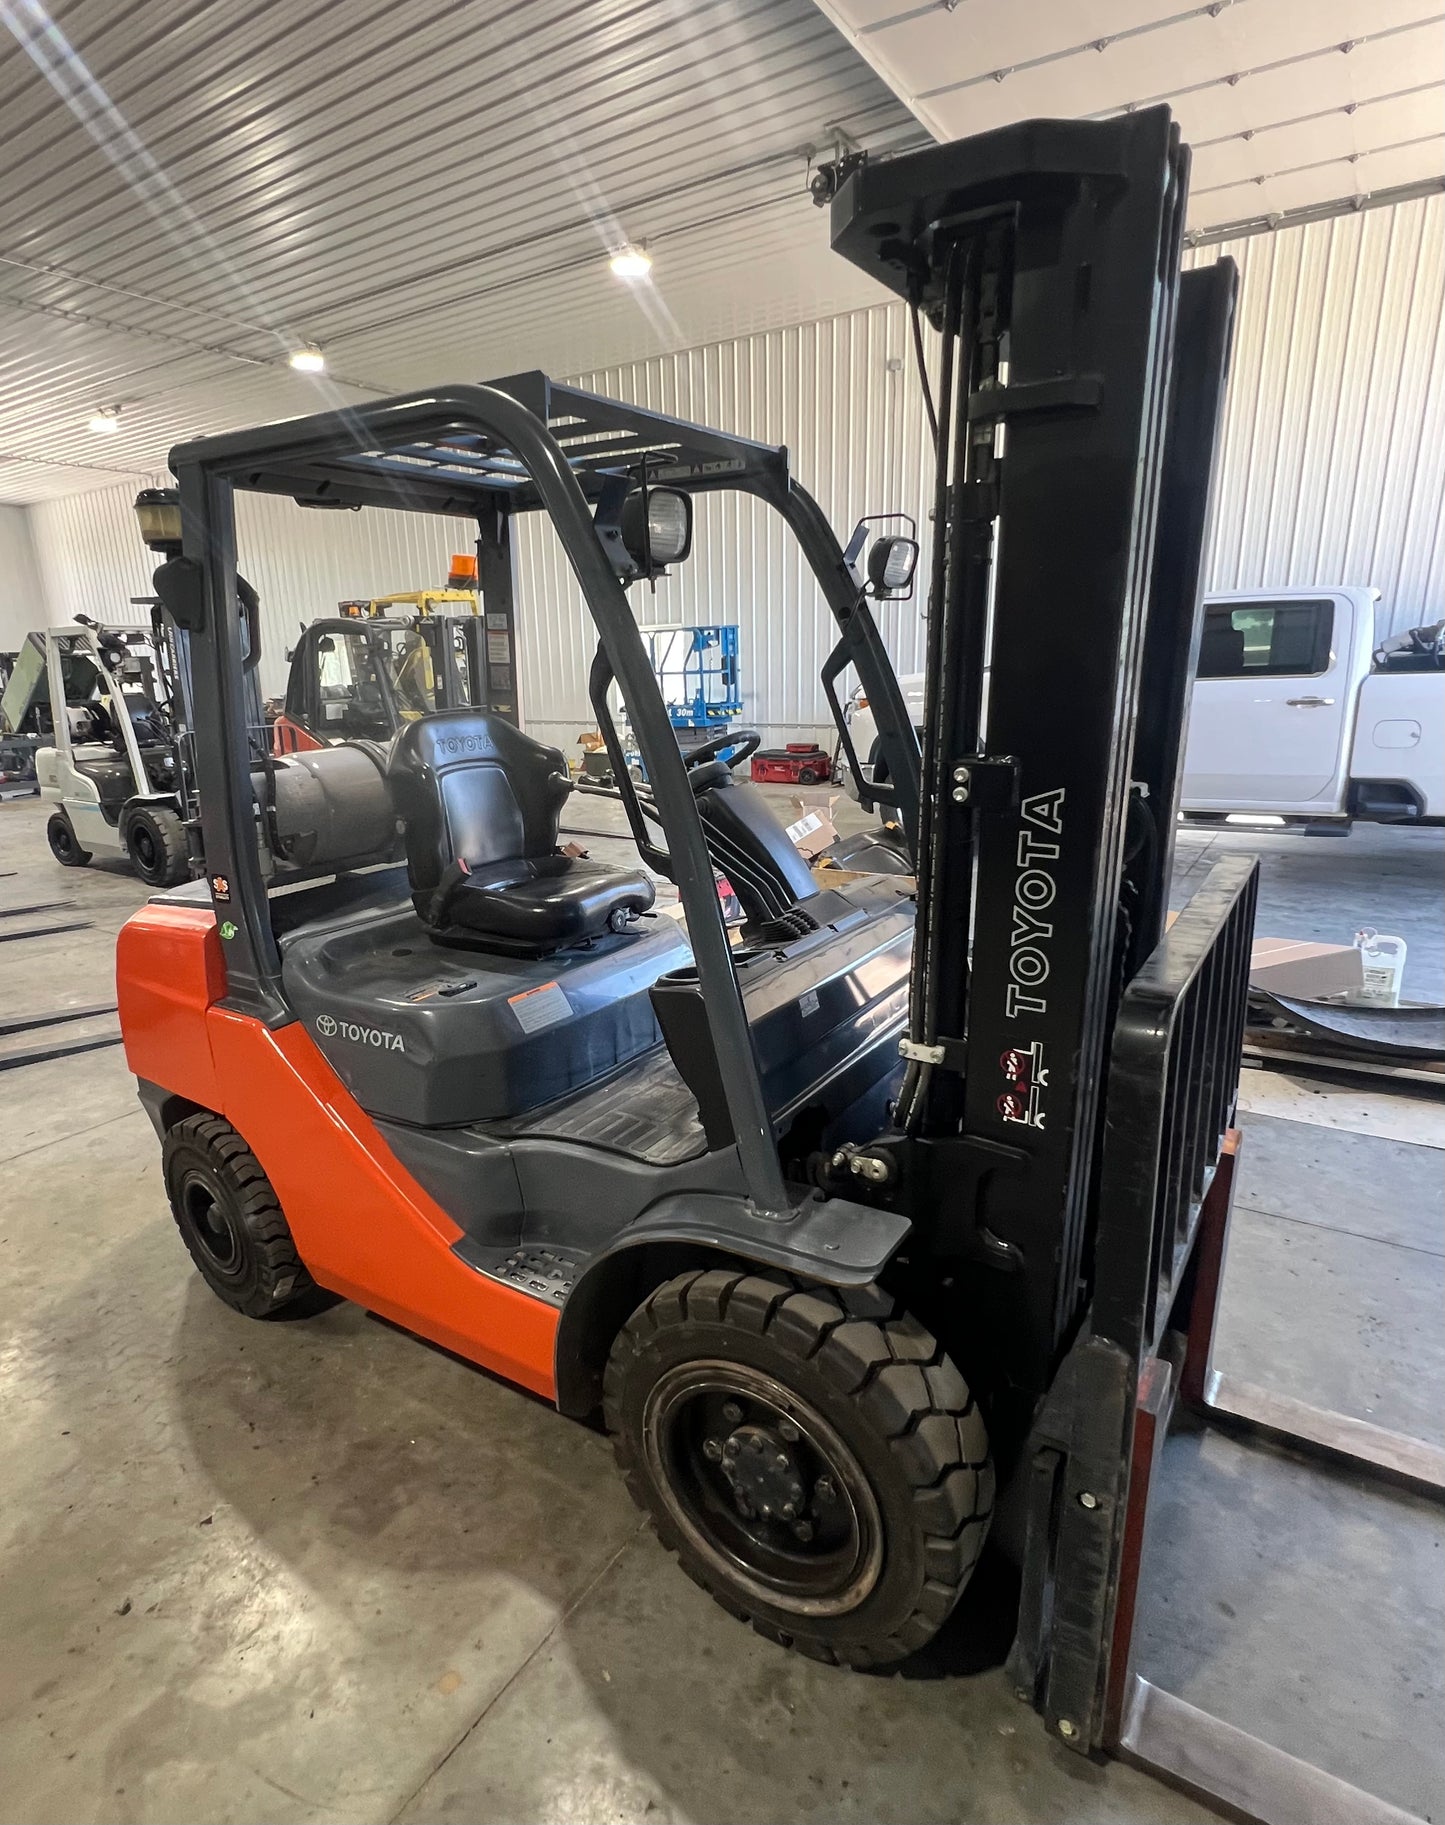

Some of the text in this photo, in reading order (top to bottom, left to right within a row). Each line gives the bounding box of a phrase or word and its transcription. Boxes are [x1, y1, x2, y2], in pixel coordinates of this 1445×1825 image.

[436, 735, 494, 755] TOYOTA
[1006, 787, 1066, 1019] TOYOTA
[339, 1021, 405, 1053] TOYOTA
